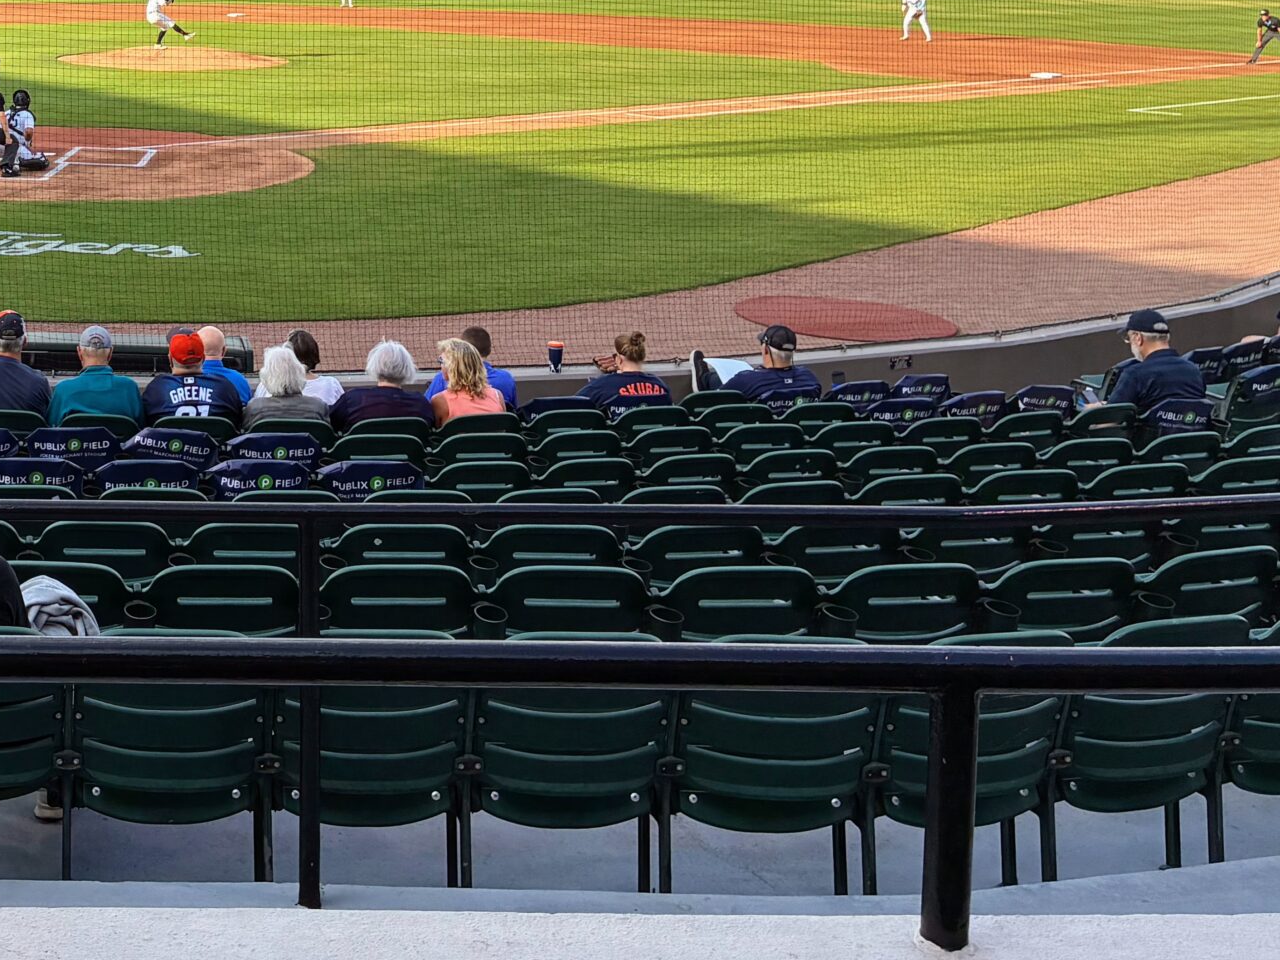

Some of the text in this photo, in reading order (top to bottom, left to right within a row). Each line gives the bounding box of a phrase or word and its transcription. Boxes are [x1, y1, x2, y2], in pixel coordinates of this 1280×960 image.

[169, 386, 214, 404] GREENE
[873, 412, 902, 420] PUBLIX
[34, 440, 110, 451] PUBLIX FIELD
[134, 435, 211, 455] PUBLIX FIELD
[153, 451, 182, 459] MARCHANT
[240, 447, 315, 459] PUBLIX FIELD
[46, 474, 75, 485] FIELD
[160, 479, 189, 489] FIELD
[220, 476, 302, 489] PUBLIX FIELD
[332, 476, 415, 491] PUBLIX FIELD
